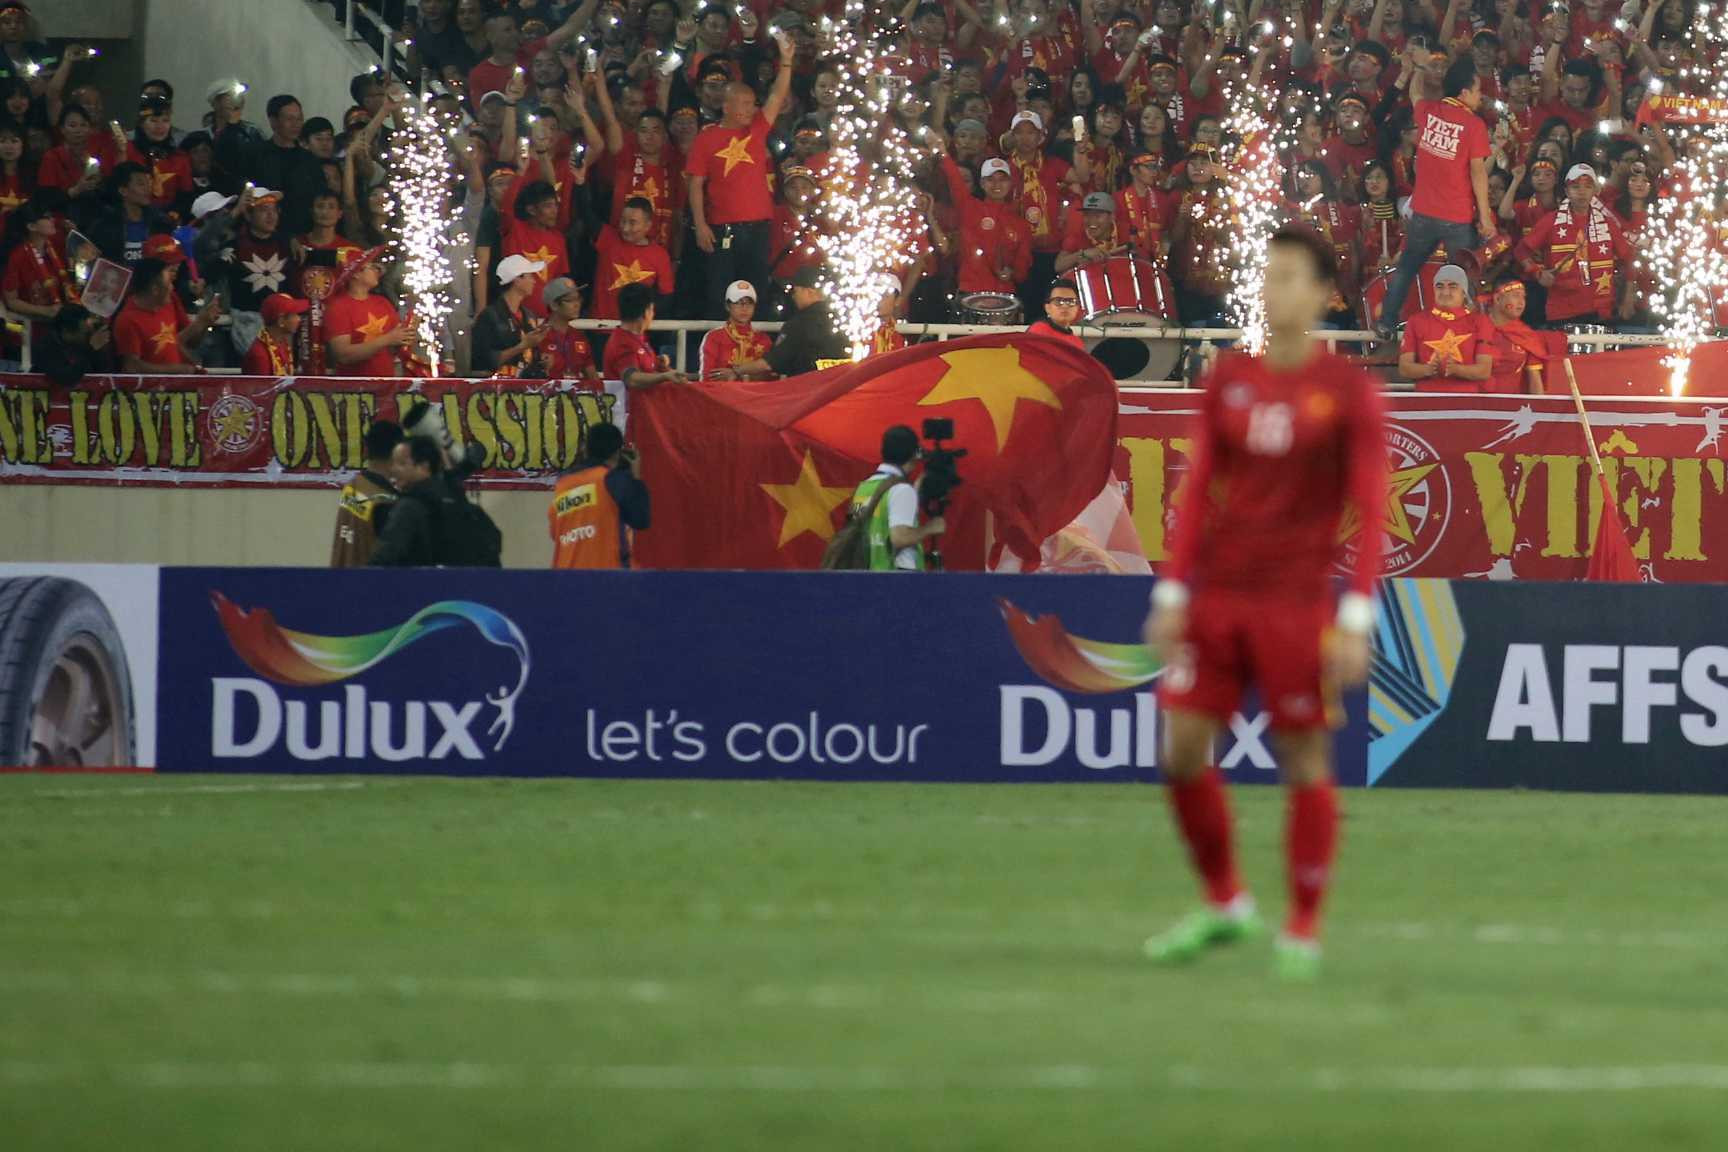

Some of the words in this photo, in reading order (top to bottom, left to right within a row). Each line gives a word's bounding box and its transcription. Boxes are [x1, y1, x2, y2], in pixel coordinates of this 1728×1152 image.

[1421, 128, 1459, 152] NAM
[1427, 113, 1464, 138] VIET
[69, 390, 201, 468] LOVE
[212, 677, 486, 760] Dulux
[586, 708, 705, 762] let's
[726, 711, 928, 764] colour
[1000, 684, 1278, 770] Dulx
